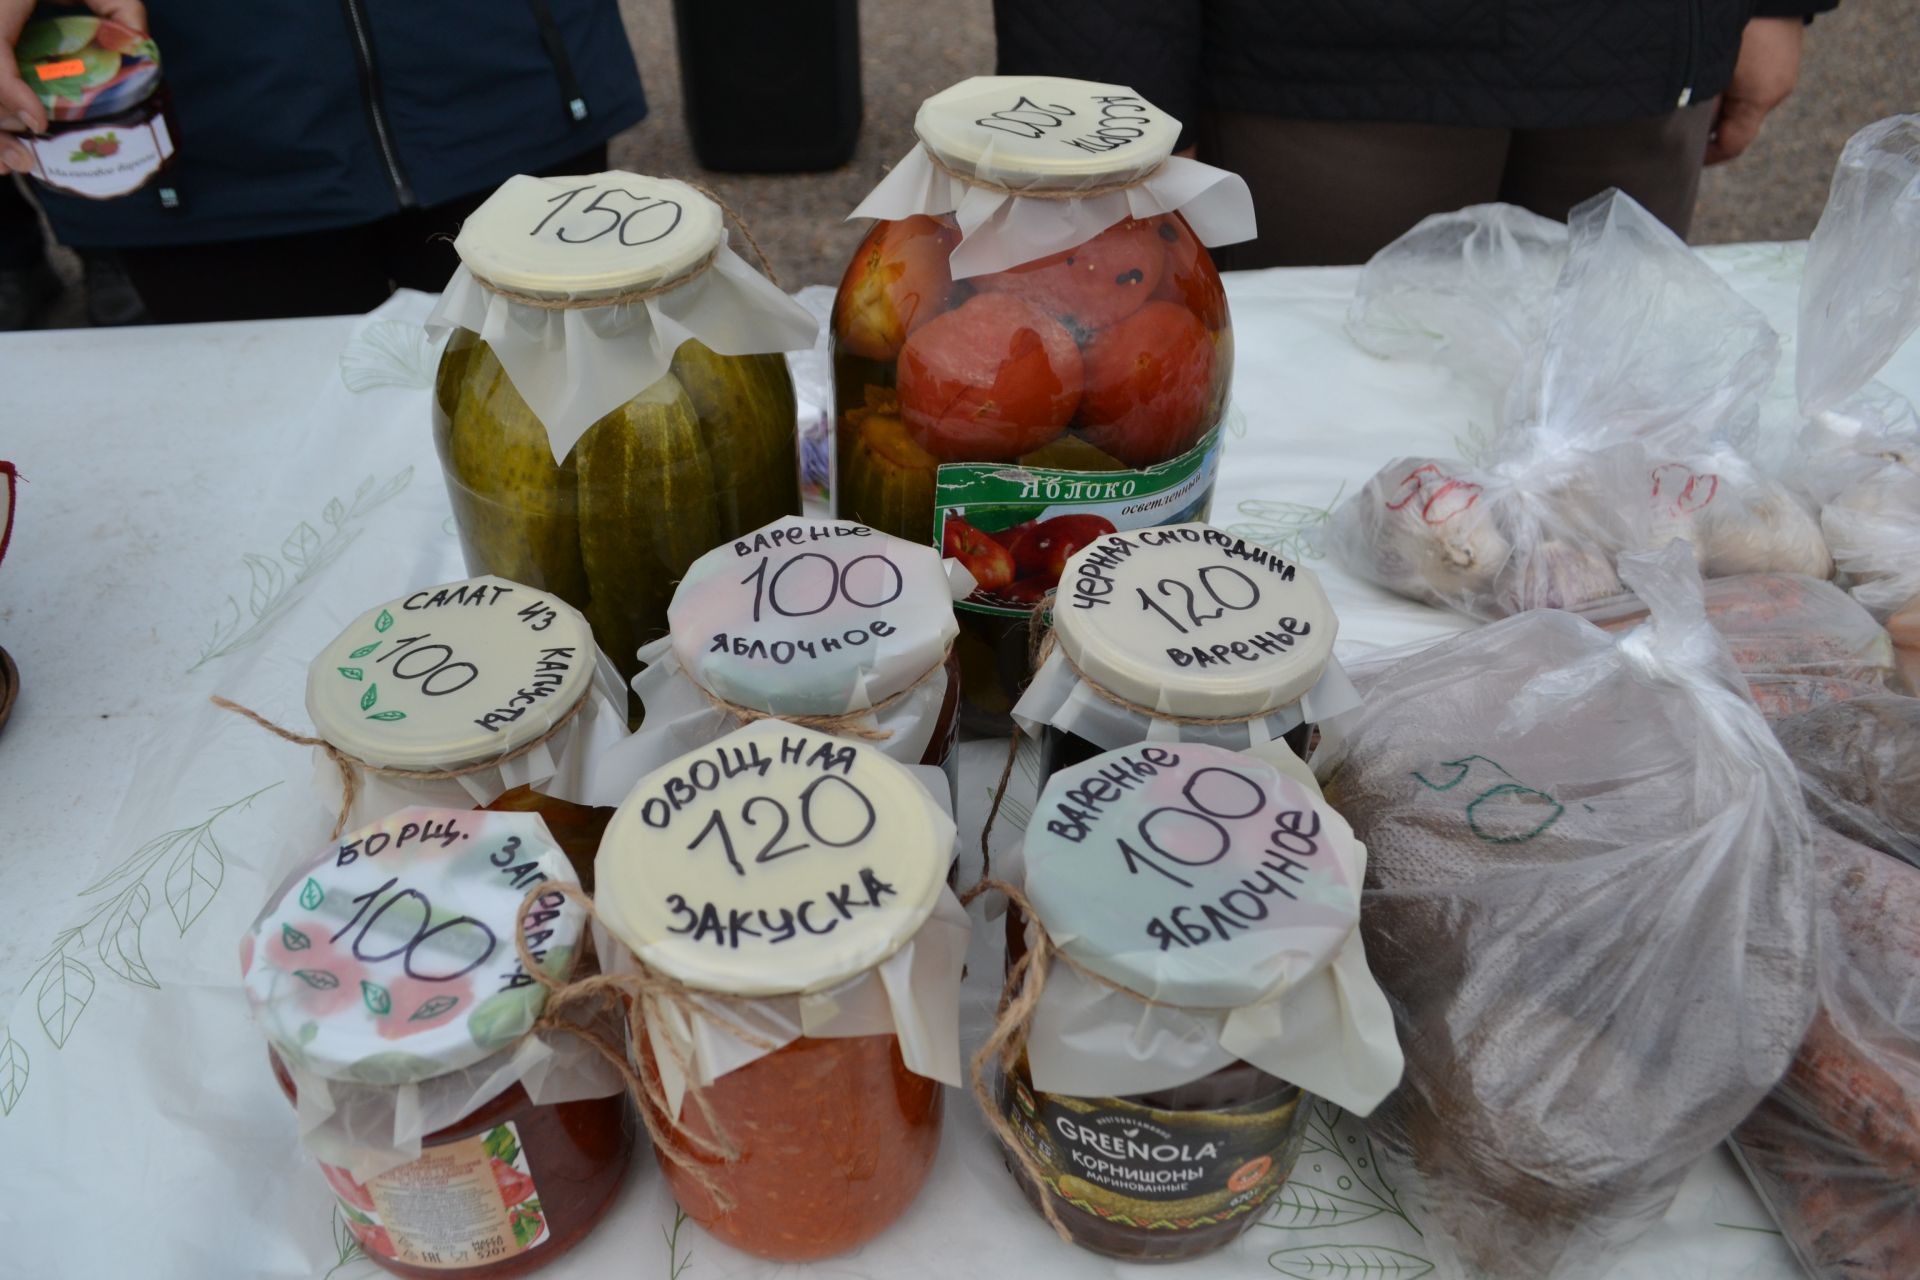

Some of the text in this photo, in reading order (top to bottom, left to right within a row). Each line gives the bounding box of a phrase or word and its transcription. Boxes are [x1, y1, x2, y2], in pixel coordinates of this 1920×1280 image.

[529, 185, 683, 246] 150
[740, 552, 904, 622] 100
[1136, 565, 1261, 634] 120
[376, 633, 479, 696] 100
[403, 585, 576, 733] САЛАТ ИЗ КАПУСТЫ
[686, 774, 876, 876] 120
[1116, 767, 1267, 888] 100
[329, 877, 497, 981] 100
[666, 867, 897, 949] ЗАКУСКА
[1055, 1116, 1218, 1162] GREENOLA
[1071, 1149, 1203, 1184] КОРНИШОНЫ
[1086, 1170, 1189, 1193] МАРИНОВАННЫЕ
